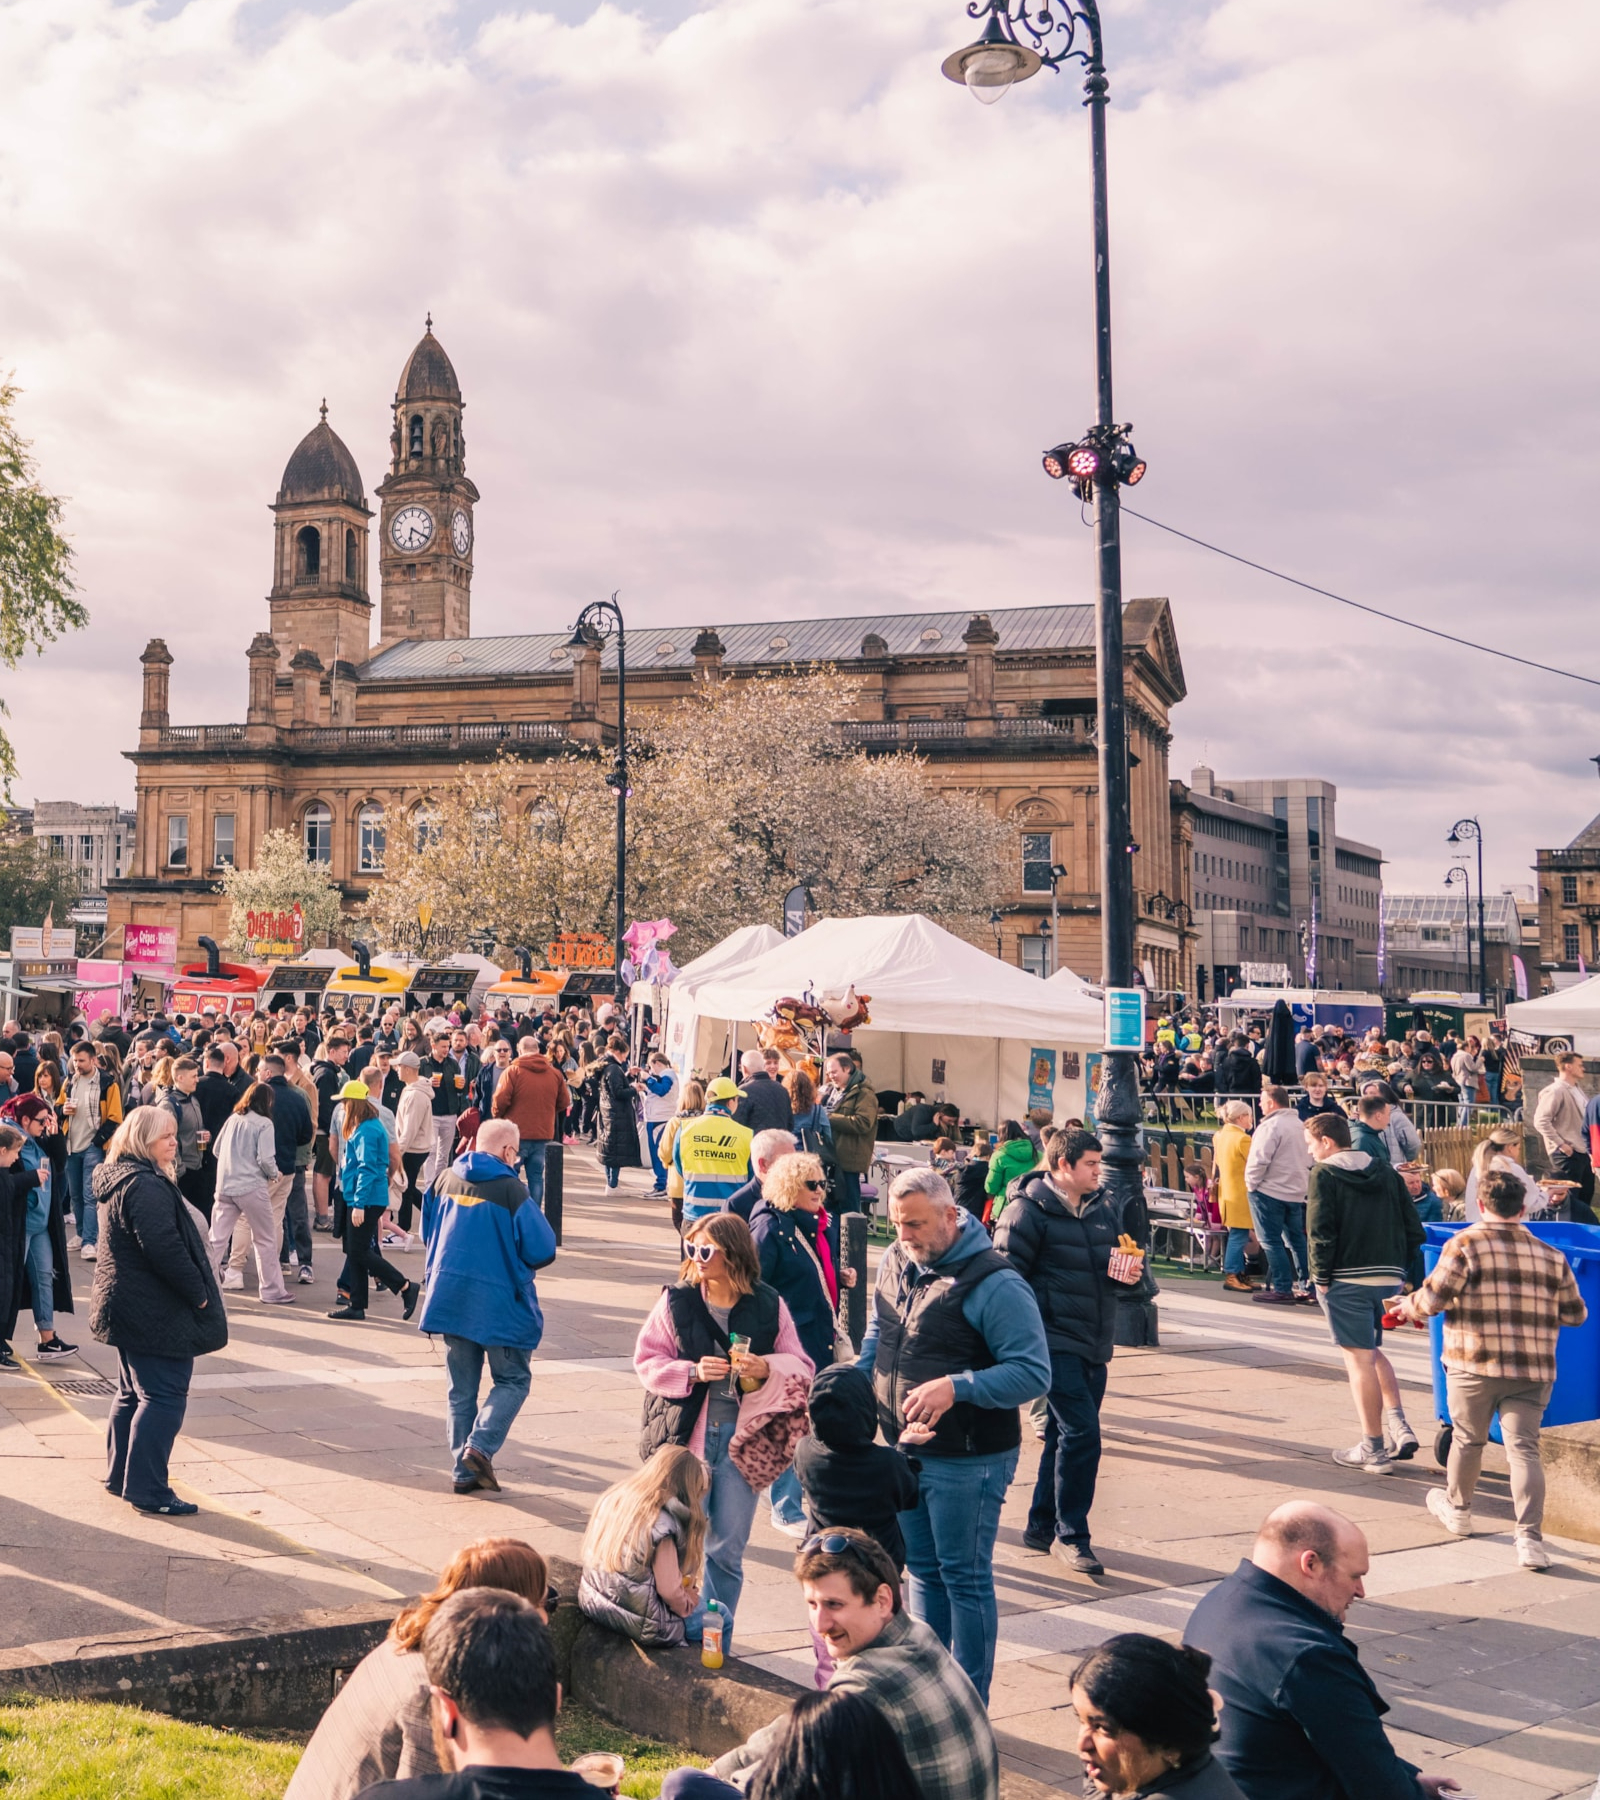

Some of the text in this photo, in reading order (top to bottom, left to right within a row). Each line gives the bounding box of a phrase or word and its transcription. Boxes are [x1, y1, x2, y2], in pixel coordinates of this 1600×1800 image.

[246, 911, 276, 940] DIRTY
[548, 943, 615, 967] CHURROS
[693, 1135, 717, 1143] SGL
[693, 1150, 737, 1160] STEWARD
